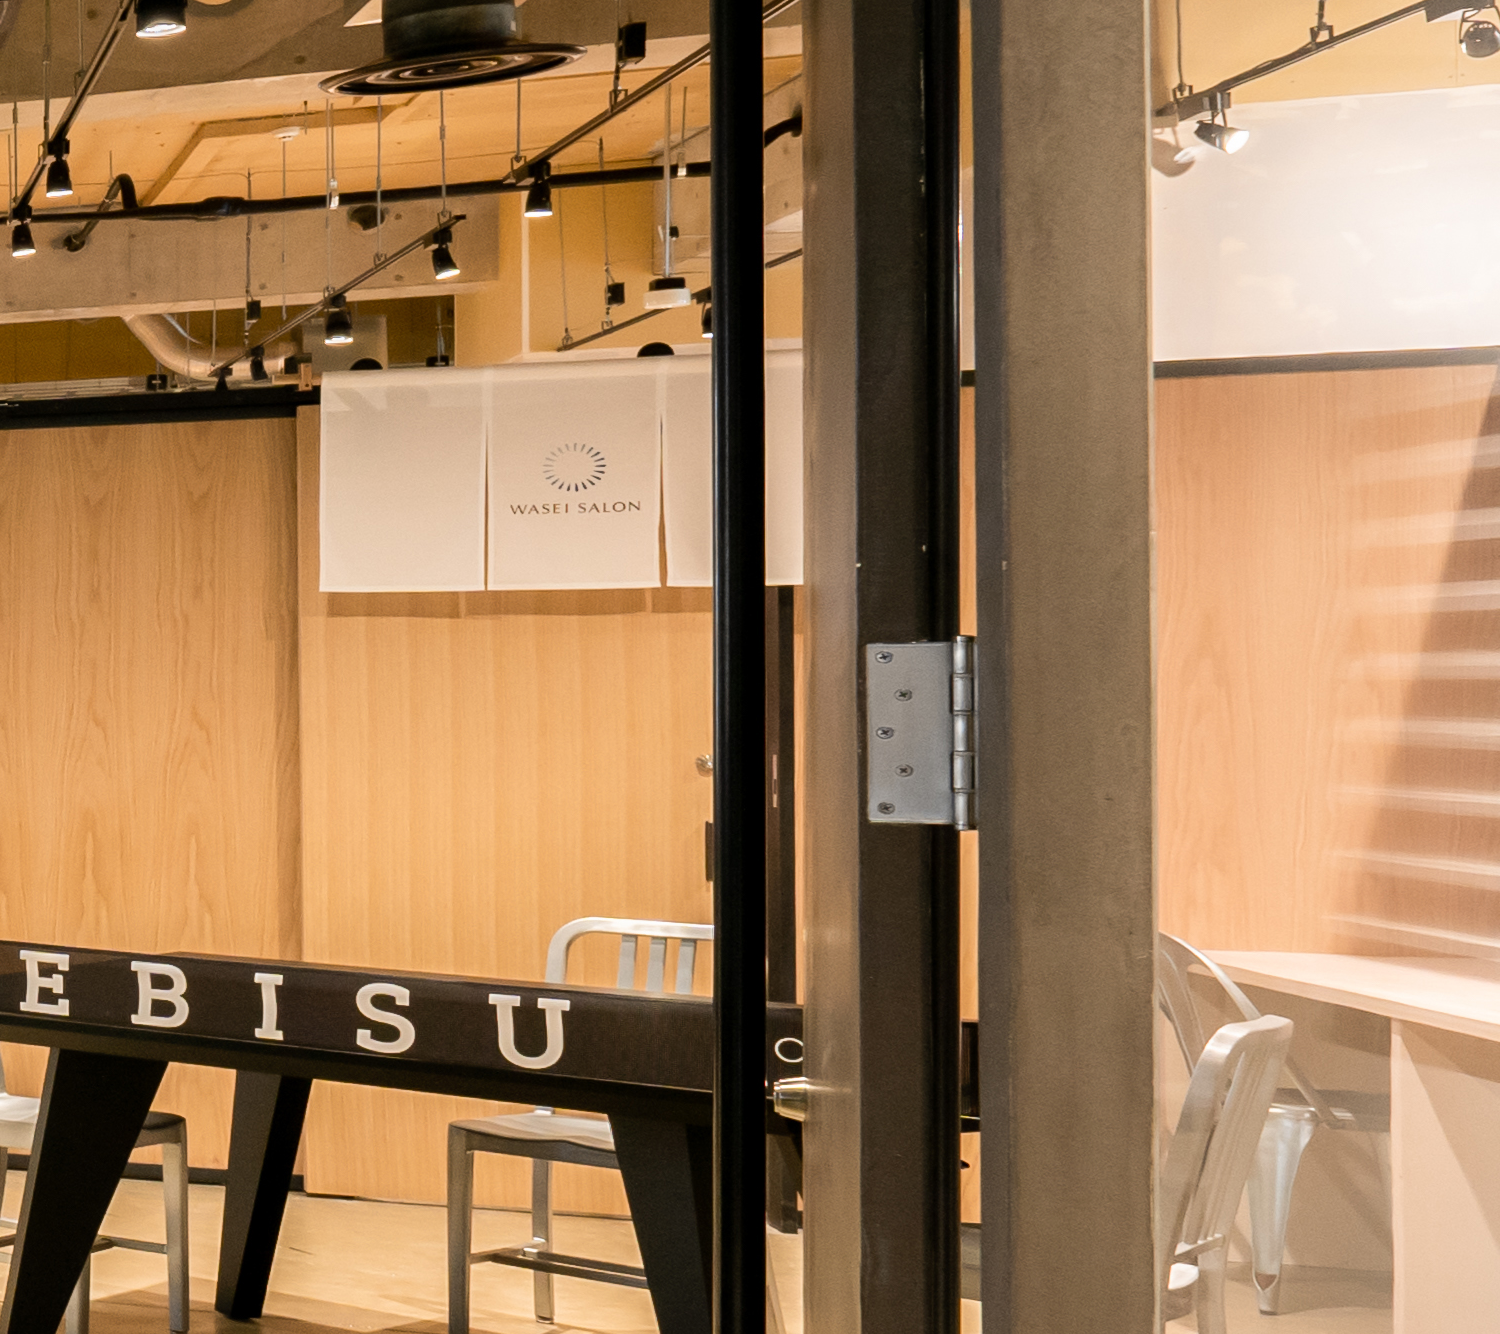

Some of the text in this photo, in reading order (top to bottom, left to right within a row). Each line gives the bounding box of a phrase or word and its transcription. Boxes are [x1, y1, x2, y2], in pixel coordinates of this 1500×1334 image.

[510, 500, 641, 515] WASEI SALON
[19, 948, 571, 1070] EBISU
